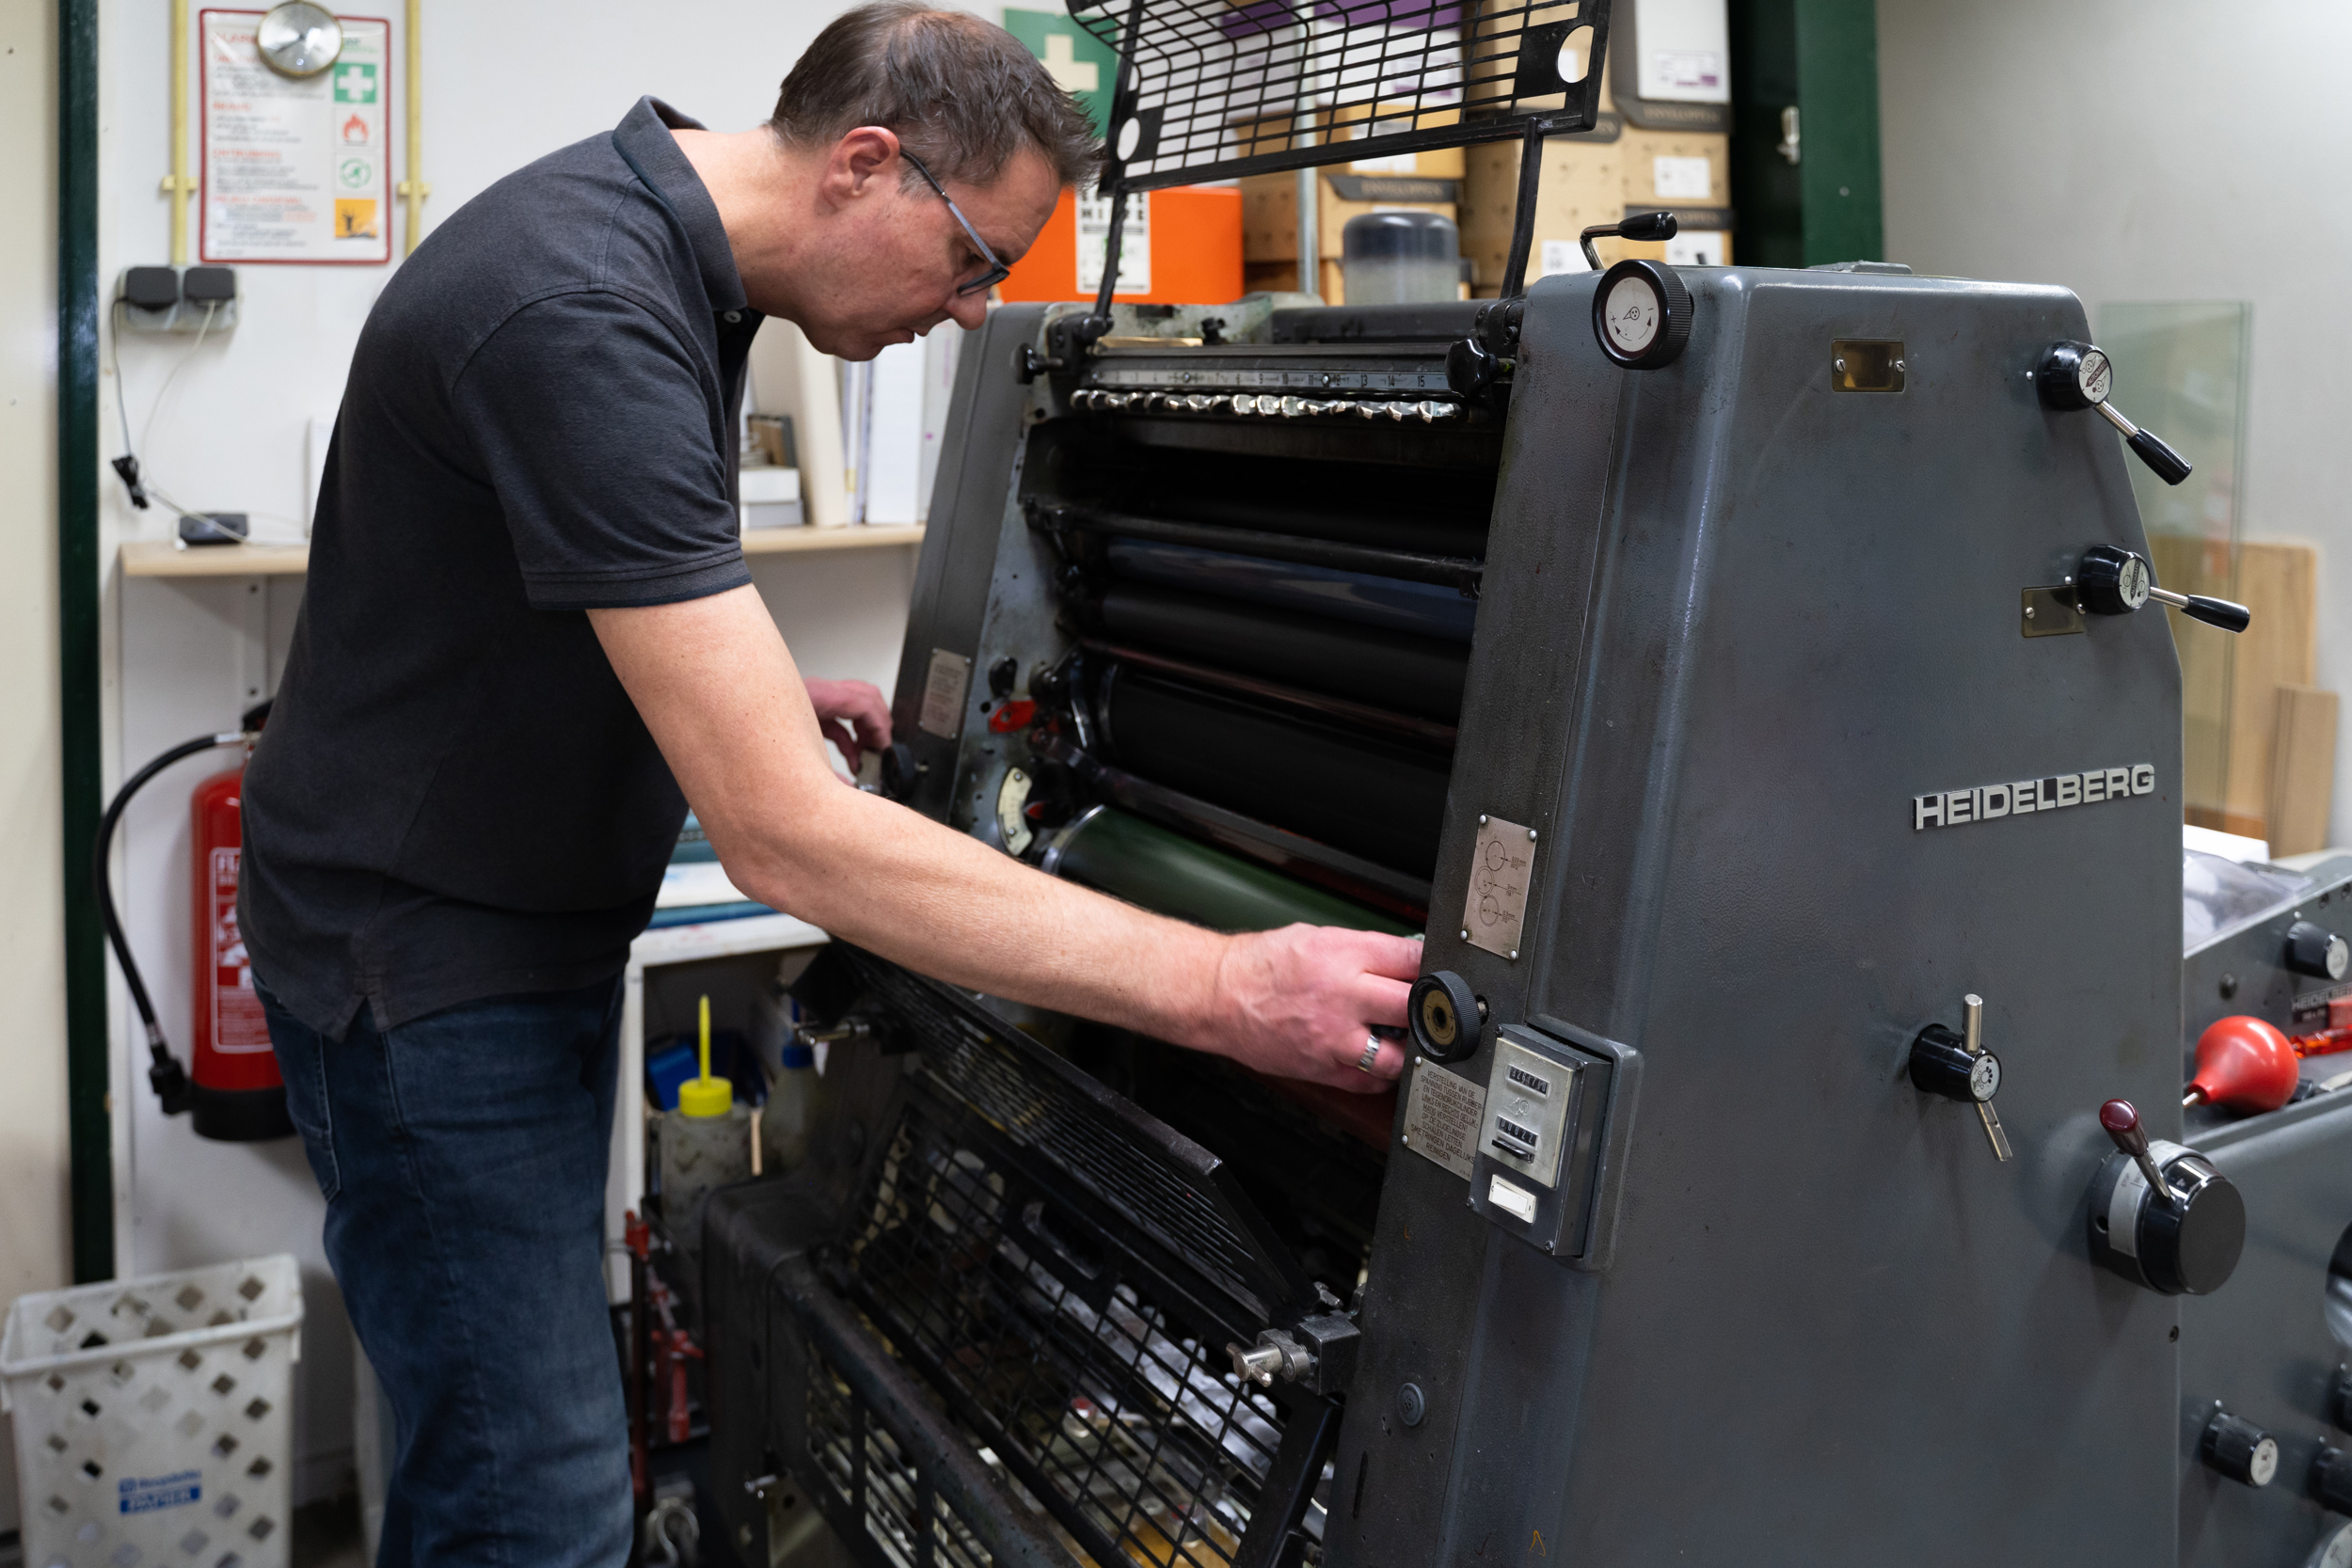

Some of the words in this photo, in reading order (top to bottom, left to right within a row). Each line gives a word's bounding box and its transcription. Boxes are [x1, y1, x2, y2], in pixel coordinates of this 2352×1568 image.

[1360, 374, 1368, 388] 13
[1388, 374, 1395, 388] 14
[1417, 375, 1425, 388] 15
[1915, 764, 2155, 830] HEIDELBERG
[1420, 1074, 1443, 1091] SPANNING
[1443, 1086, 1461, 1100] TUSSEN
[1422, 1084, 1429, 1093] EN
[1427, 1069, 1457, 1090] VERSTELLING
[1458, 1084, 1467, 1094] VAN
[1468, 1089, 1475, 1098] DE
[1421, 1092, 1434, 1105] LINKS
[1434, 1099, 1441, 1108] EN
[1441, 1102, 1459, 1118] RECHTS
[1422, 1103, 1436, 1116] MATIG
[1422, 1112, 1428, 1121] OP
[1429, 1115, 1435, 1124] DE
[1421, 1121, 1443, 1138] SCHALEN
[1410, 1123, 1444, 1147] SMETRINGEN
[1445, 1142, 1475, 1164] DAGELIJKS
[1425, 1142, 1451, 1161] REINIGEN
